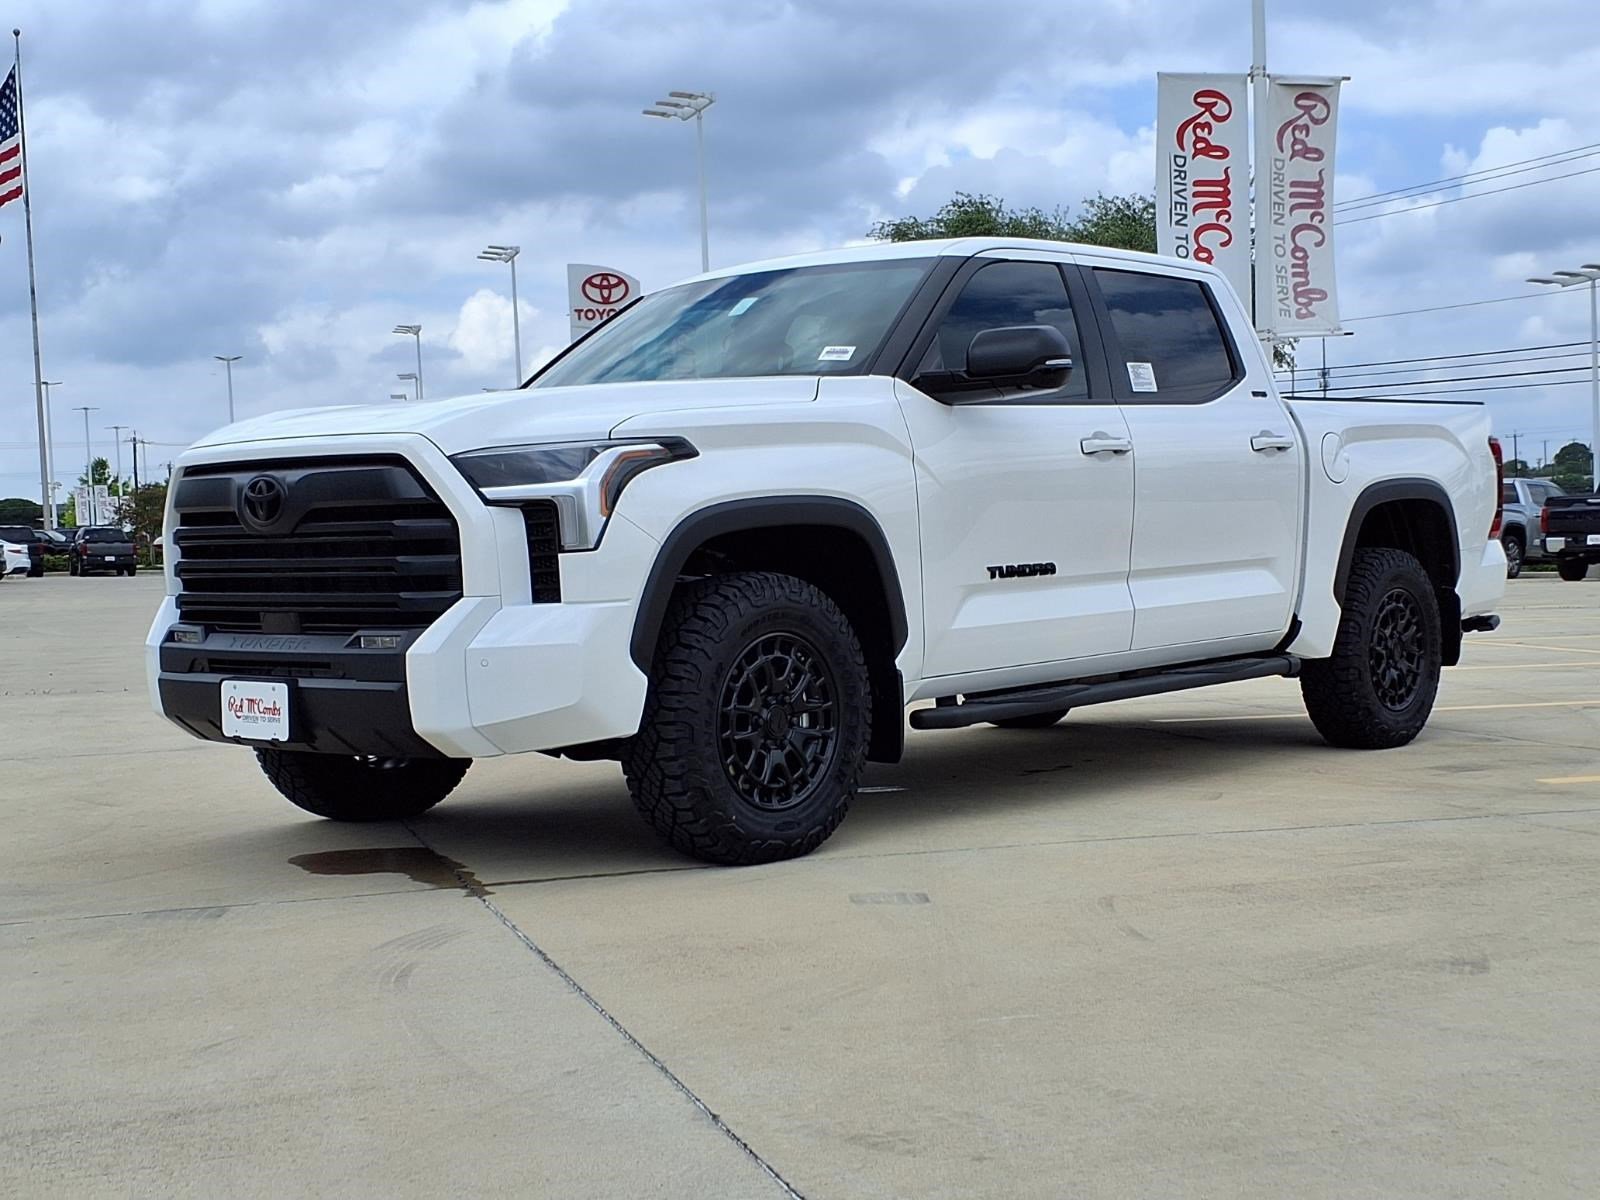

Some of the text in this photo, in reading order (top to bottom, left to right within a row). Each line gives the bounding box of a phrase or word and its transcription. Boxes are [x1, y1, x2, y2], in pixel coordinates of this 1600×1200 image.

[1173, 154, 1190, 259] DRIVEN TO
[1176, 89, 1233, 265] Red McCo
[1276, 91, 1331, 320] Red McCombs
[1272, 157, 1291, 319] DRIVEN TO SERVE
[573, 308, 618, 321] TOYO
[986, 562, 1057, 580] TUNDRA
[228, 695, 281, 719] Red McCombs
